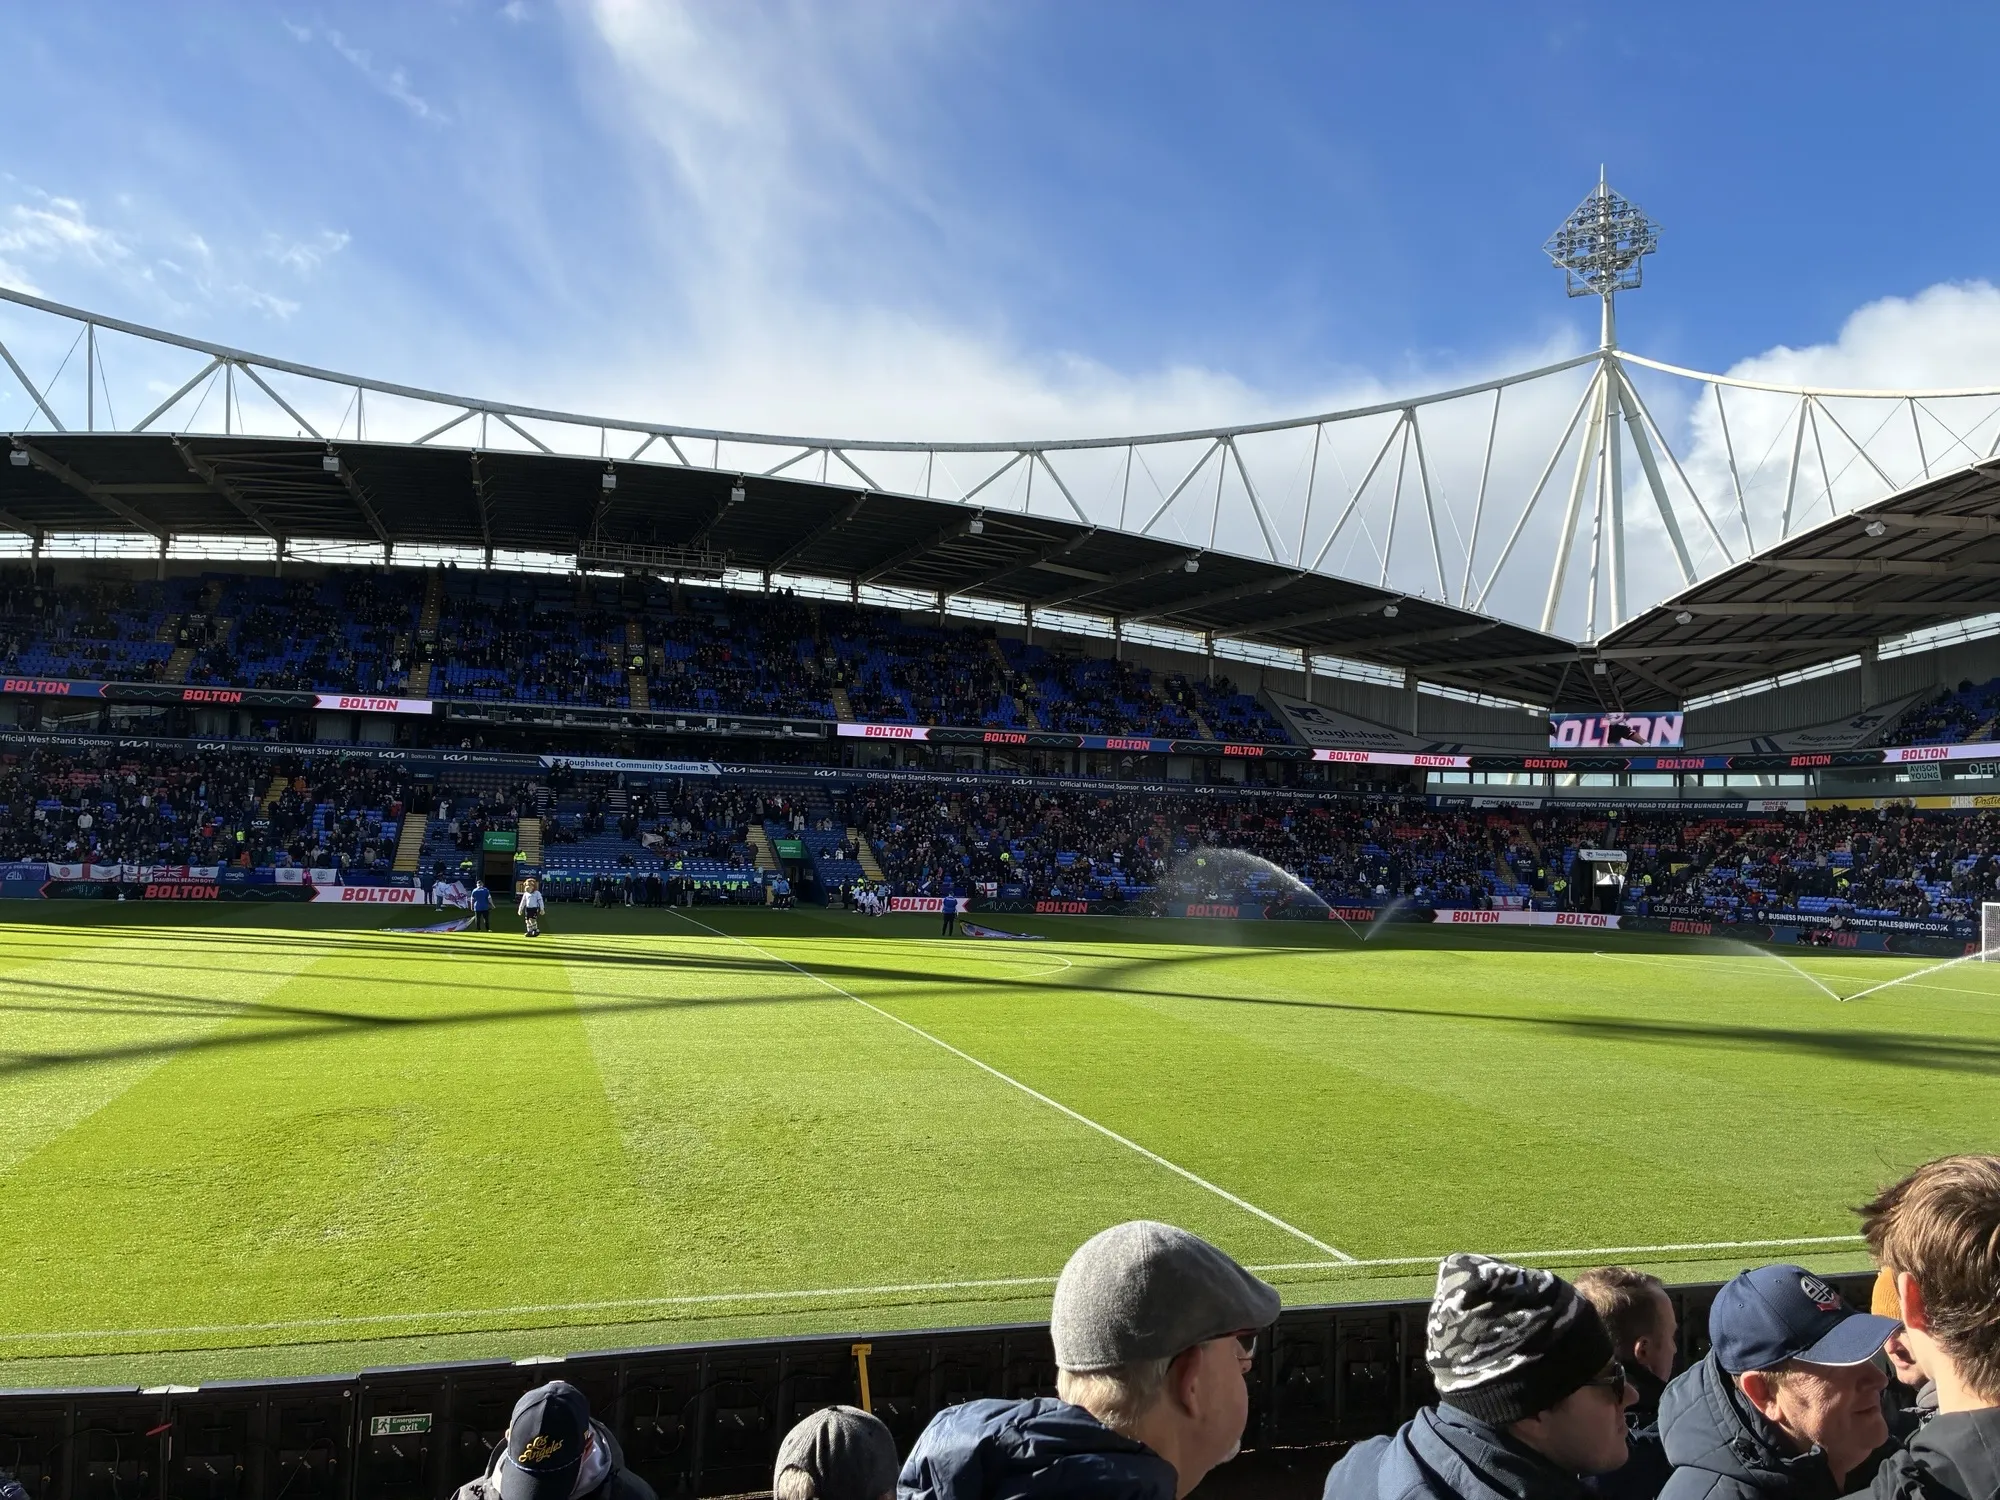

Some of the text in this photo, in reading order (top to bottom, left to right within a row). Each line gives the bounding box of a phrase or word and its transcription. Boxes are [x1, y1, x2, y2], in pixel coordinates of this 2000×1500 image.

[4, 680, 70, 694] BOLTON
[183, 689, 242, 702] BOLTON
[339, 697, 399, 711] BOLTON
[866, 726, 913, 738] BOLTON
[984, 732, 1027, 744] BOLTON
[1302, 727, 1398, 741] Toughsheet
[0, 734, 26, 742] fficial
[28, 735, 50, 744] West
[52, 737, 76, 746] Stand
[1106, 738, 1150, 751] BOLTON
[1311, 736, 1364, 746] Community
[295, 746, 315, 754] West
[1224, 744, 1264, 757] BOLTON
[1901, 748, 1948, 760] BOLTON
[1329, 751, 1370, 762] BOLTON
[1414, 756, 1456, 766] BOLTON
[1790, 755, 1831, 767] BOLTON
[566, 759, 613, 769] Toughsheet
[616, 761, 663, 771] Community
[1524, 759, 1568, 769] BOLTON
[1656, 758, 1705, 770] BOLTON
[145, 884, 220, 898] BOLTON
[342, 888, 416, 902] BOLTON
[1036, 901, 1088, 913] BOLTON
[1187, 904, 1238, 918] BOLTON
[1669, 905, 1689, 915] jones
[1328, 908, 1375, 920] BOLTON
[1452, 912, 1500, 923] BOLTON
[1556, 913, 1607, 926] BOLTON
[1670, 920, 1712, 934] BOLTON
[1847, 918, 1877, 926] CONTACT
[399, 1424, 418, 1432] exit
[526, 1434, 549, 1449] Los
[518, 1439, 564, 1462] Angeles
